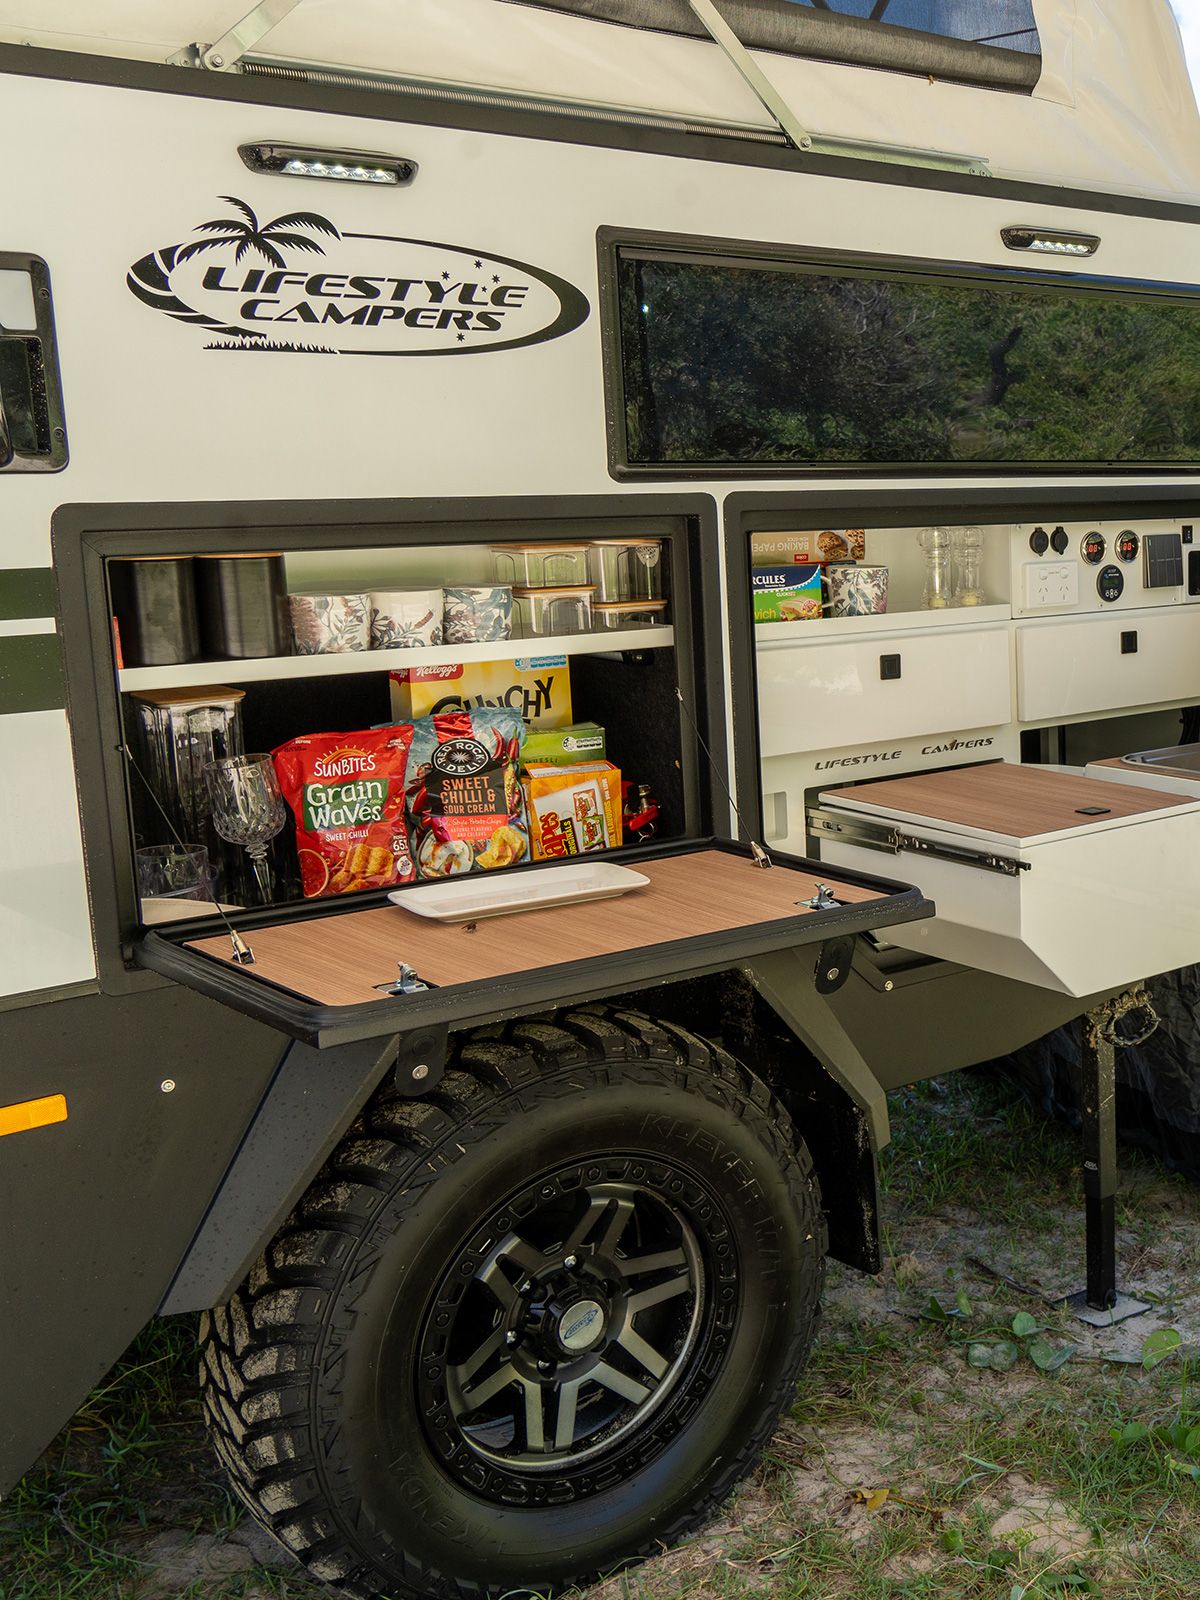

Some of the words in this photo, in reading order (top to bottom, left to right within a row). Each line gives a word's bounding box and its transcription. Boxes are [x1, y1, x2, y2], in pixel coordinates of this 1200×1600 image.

[201, 266, 529, 307] LIFESTYLE
[240, 299, 505, 331] CAMPERS
[752, 543, 774, 552] PAPE
[779, 541, 809, 551] BAKING
[437, 745, 452, 764] RED
[456, 743, 485, 760] ROCK
[815, 750, 902, 771] LIFESTYLE
[921, 737, 994, 755] CAMPERS
[446, 762, 480, 773] DELI
[442, 776, 489, 791] SWEET
[306, 781, 383, 807] Grain
[440, 790, 482, 804] CHILLI
[487, 789, 496, 802] &
[443, 805, 465, 815] SOUR
[467, 803, 496, 813] CREAM
[325, 832, 347, 842] SWEET
[349, 829, 369, 839] CHILLI
[563, 820, 579, 855] ORIGINALS
[640, 1113, 766, 1205] KLEVER
